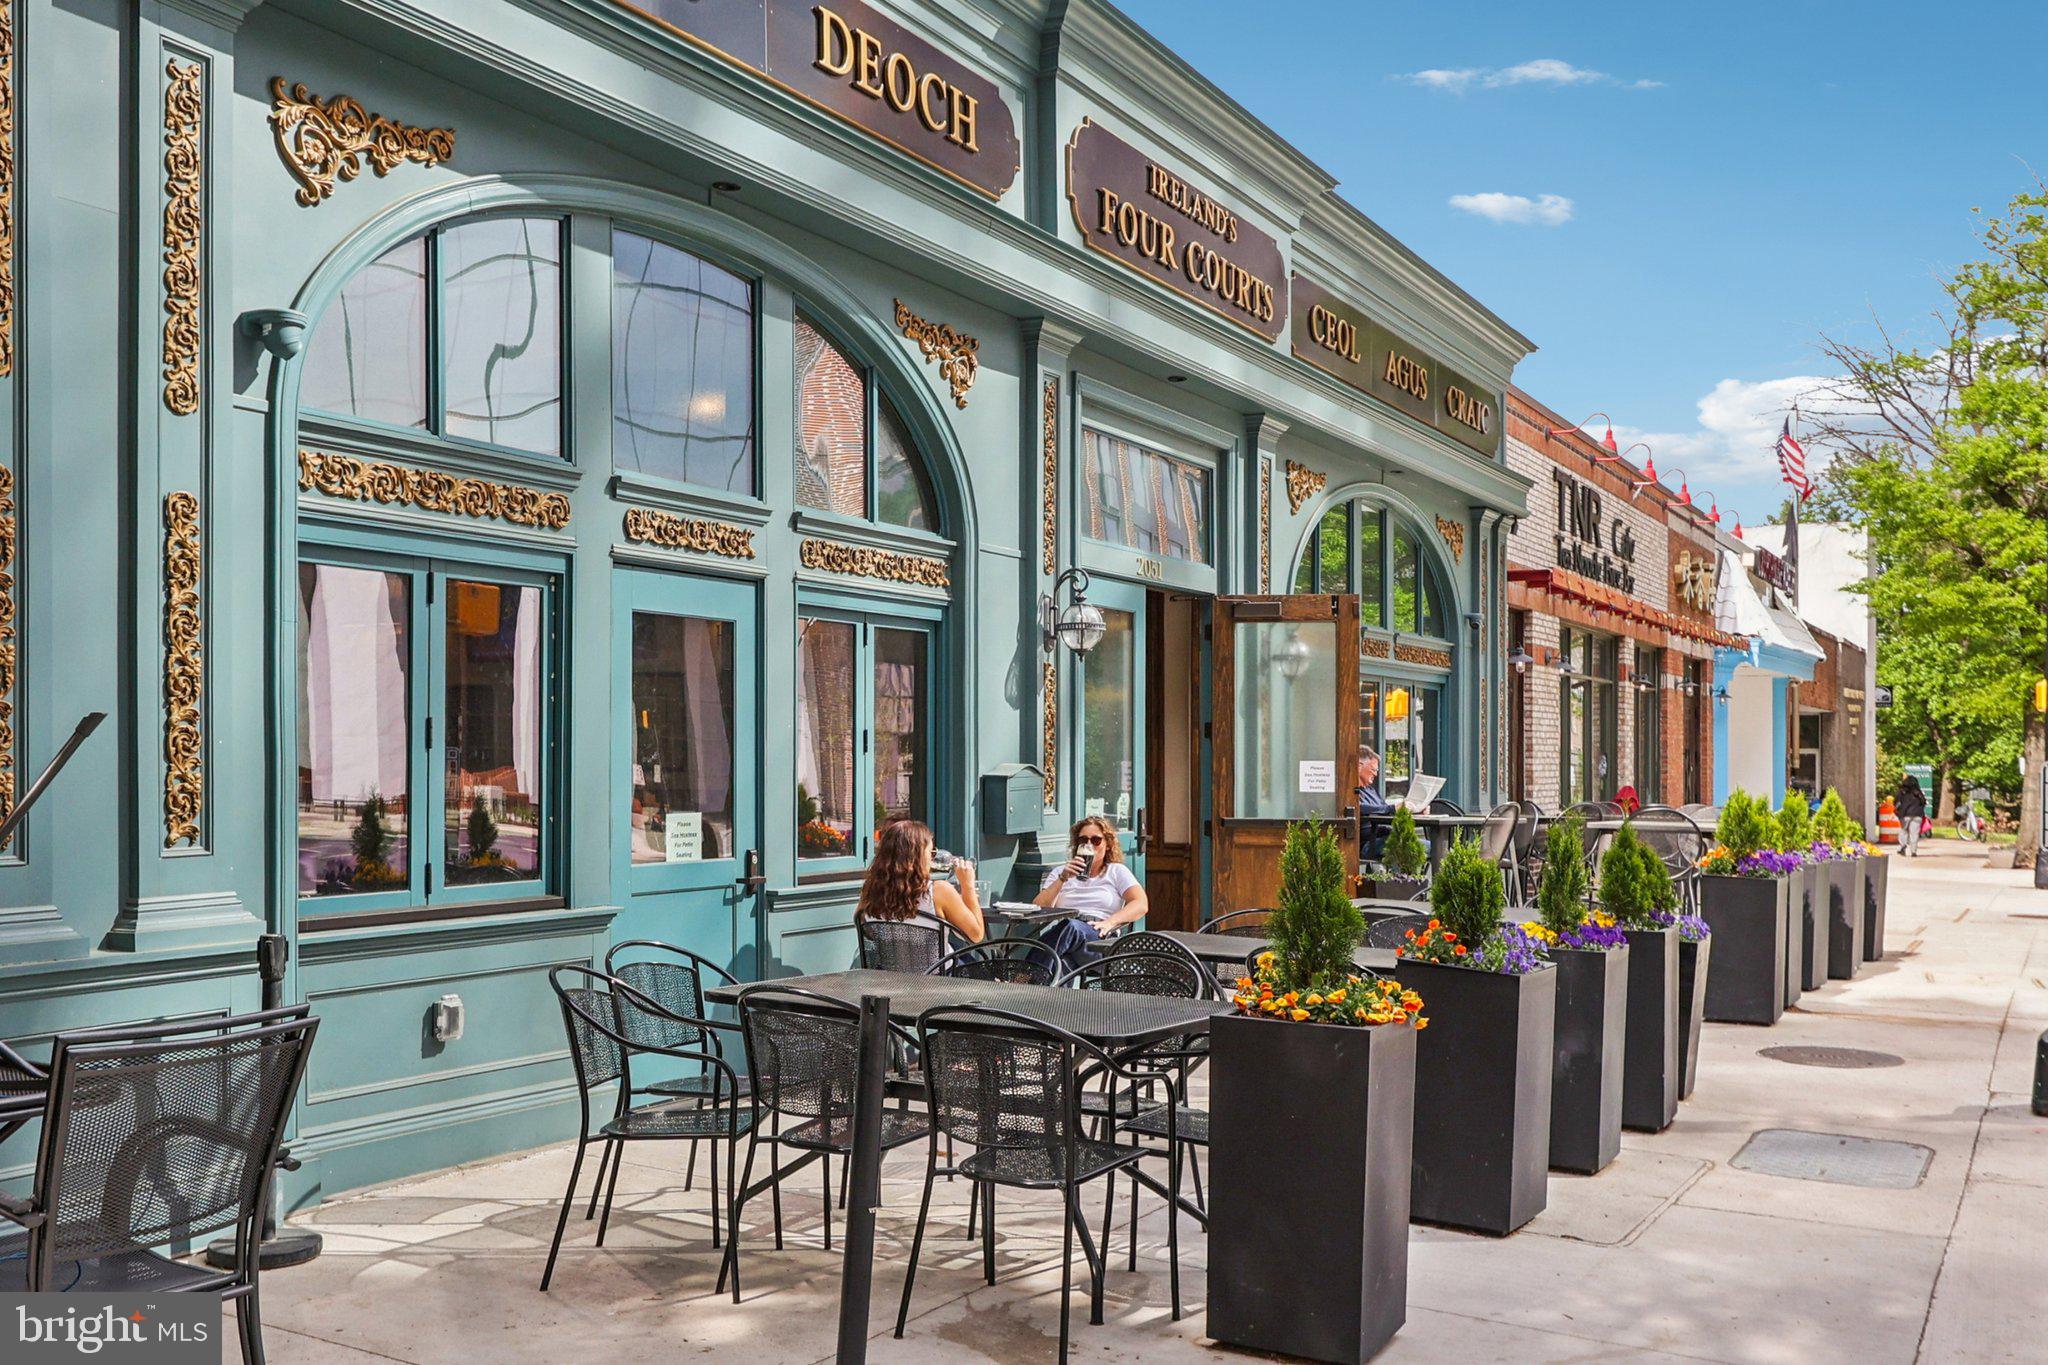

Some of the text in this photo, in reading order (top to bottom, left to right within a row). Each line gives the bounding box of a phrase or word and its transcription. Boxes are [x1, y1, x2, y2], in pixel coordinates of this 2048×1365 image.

[813, 4, 979, 154] DEOCH
[1097, 186, 1274, 323] FOUR COURTS
[1146, 163, 1238, 244] IRELAND'S
[1308, 302, 1490, 435] CEOL AGUS CRAIC
[1553, 466, 1602, 548] TNR
[1136, 556, 1164, 582] 2051
